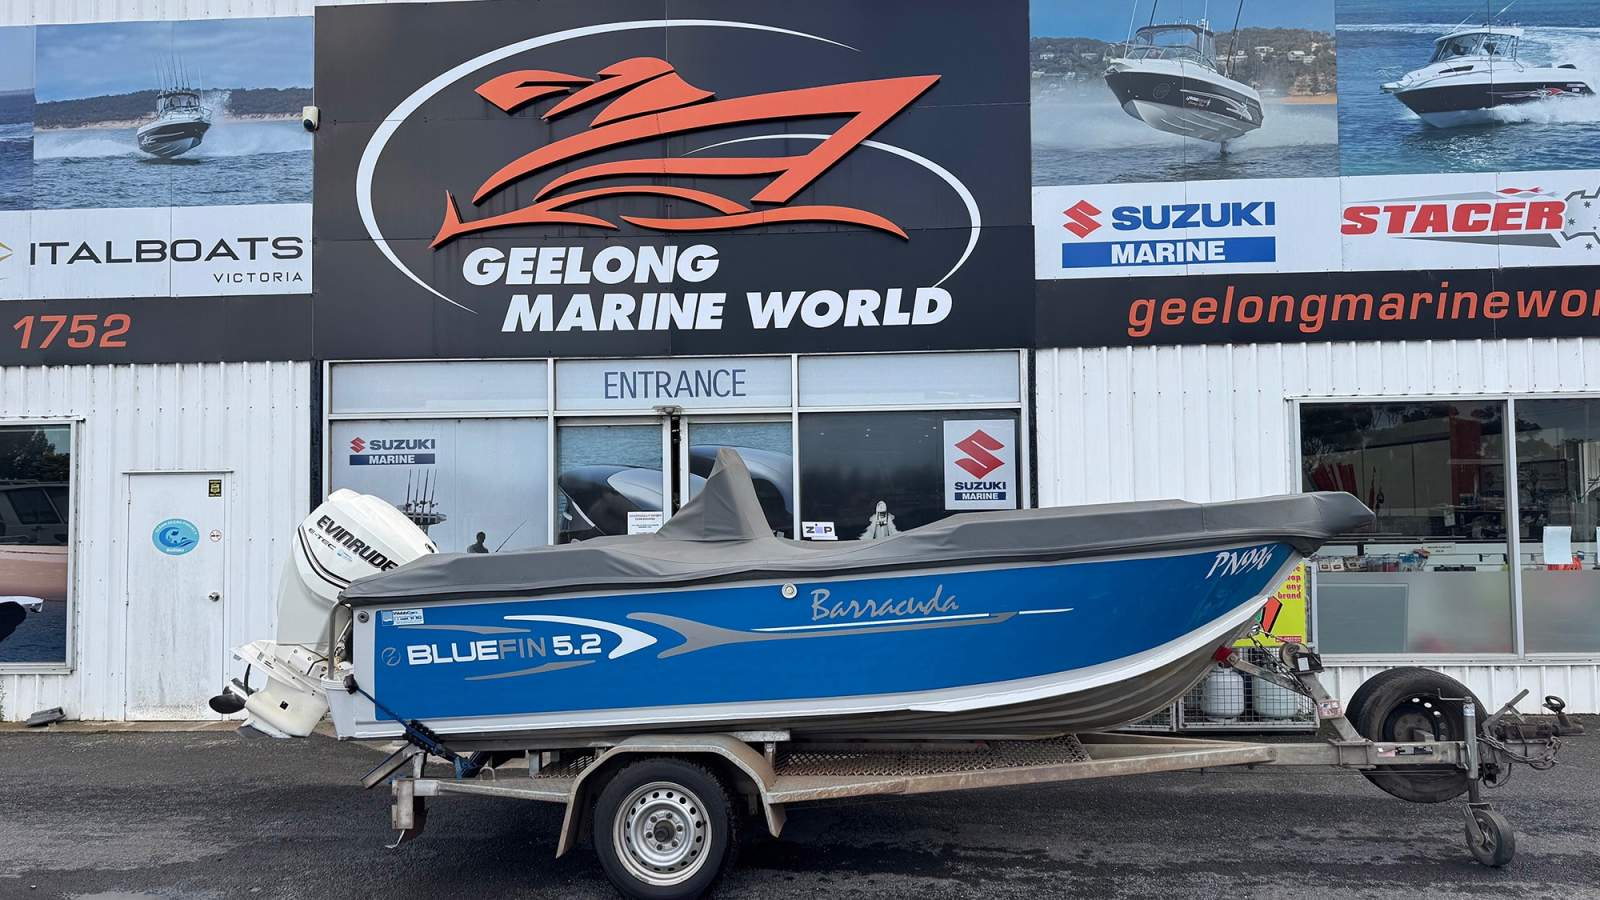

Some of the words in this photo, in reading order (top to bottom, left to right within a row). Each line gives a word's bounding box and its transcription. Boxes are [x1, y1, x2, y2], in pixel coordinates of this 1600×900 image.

[1111, 201, 1276, 232] SUZUKI
[1340, 200, 1566, 235] STACER
[29, 236, 304, 266] ITALBOATS
[462, 245, 720, 286] GEELONG
[1110, 239, 1226, 265] MARINE
[212, 271, 304, 284] VICTORIA
[501, 292, 727, 333] MARINE
[746, 287, 953, 329] WORLD
[13, 313, 131, 349] 1752
[604, 368, 746, 400] ENTRANCE
[368, 455, 416, 464] MARINE
[369, 439, 436, 450] SUZUKI
[954, 481, 1007, 490] SUZUKI
[962, 492, 999, 500] MARINE
[316, 514, 399, 572] EVINRUDE
[810, 584, 960, 622] Barracuda
[1277, 591, 1301, 599] brand
[406, 637, 547, 665] BLUEFIN
[552, 633, 602, 656] 5.2
